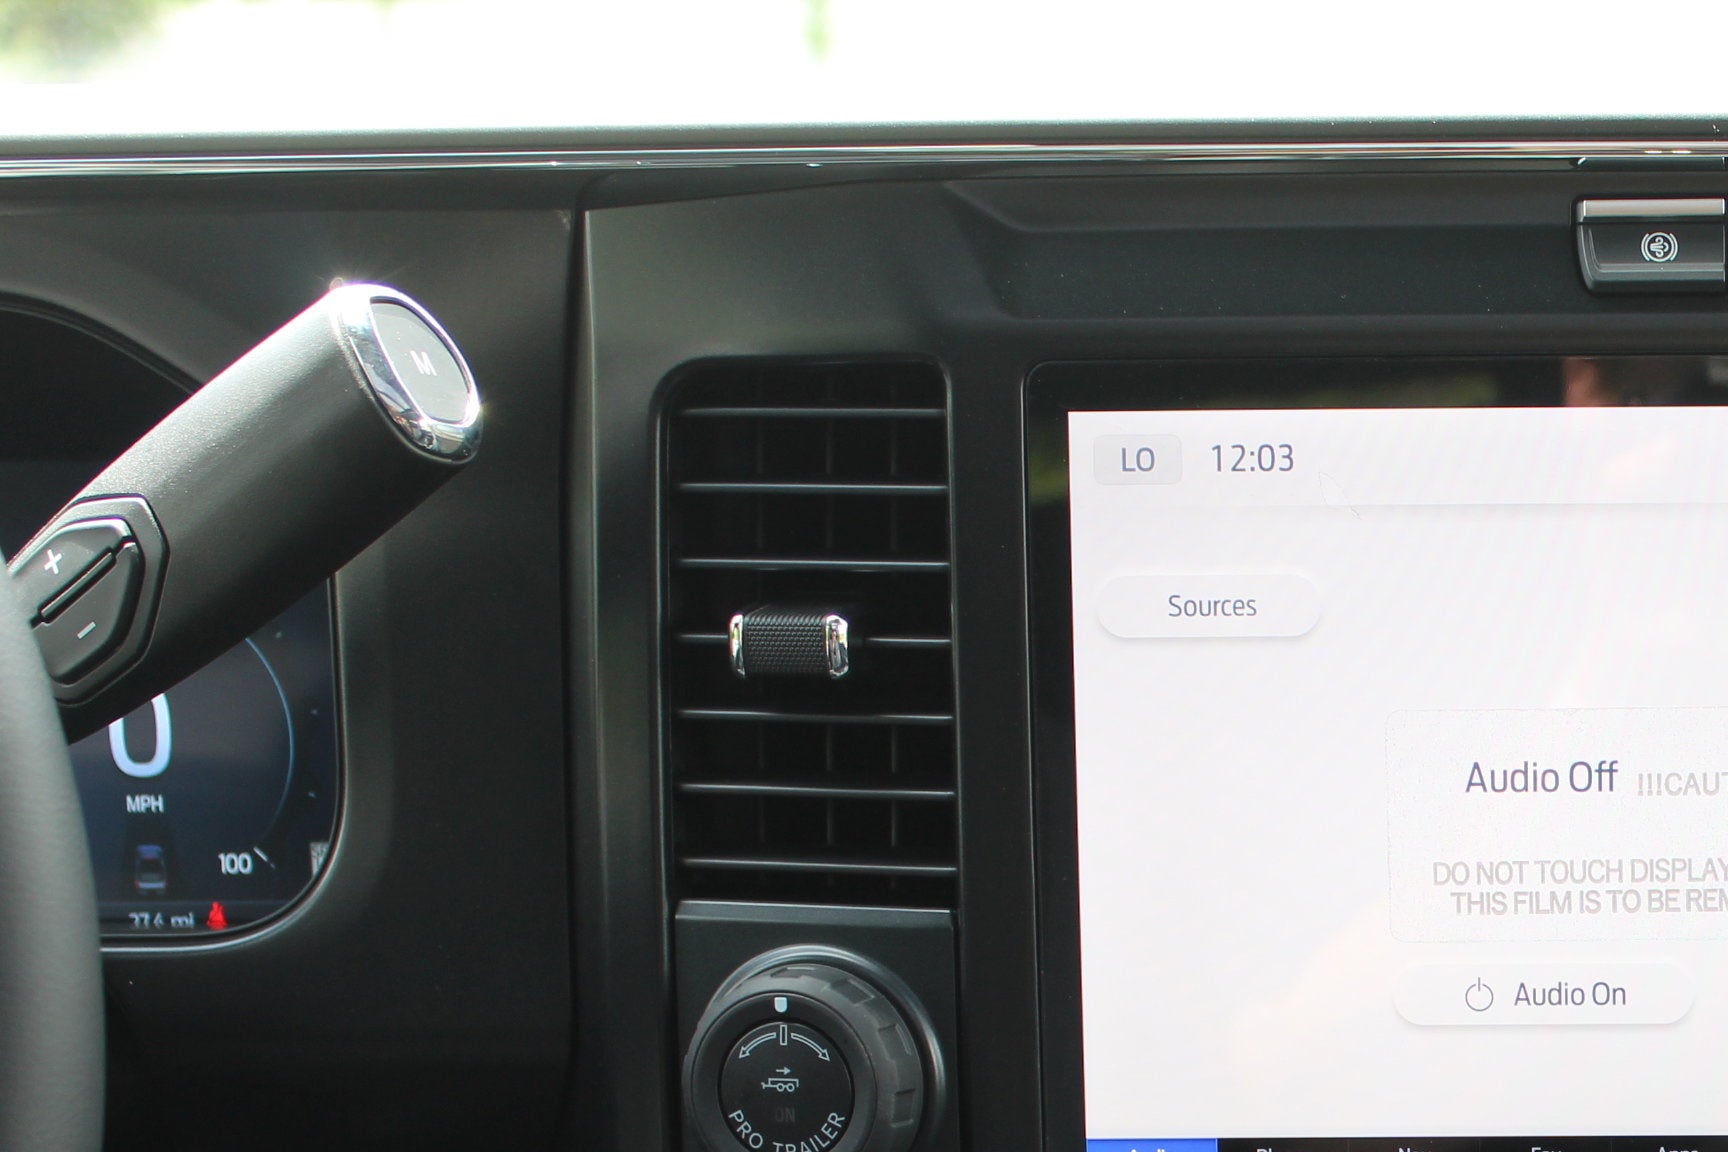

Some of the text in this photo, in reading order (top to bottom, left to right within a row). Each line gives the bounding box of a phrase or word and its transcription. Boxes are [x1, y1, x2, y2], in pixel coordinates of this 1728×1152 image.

[1121, 447, 1155, 472] LO
[1211, 443, 1294, 472] 12:03
[1168, 594, 1257, 618] Sources
[1465, 759, 1619, 793] Audio Off
[125, 794, 164, 813] MPH
[218, 852, 253, 875] 100
[1432, 860, 1471, 886] DO
[1476, 860, 1530, 886] NOT
[1533, 858, 1624, 885] TOUCH
[1449, 890, 1508, 916] THIS
[1513, 890, 1573, 915] FILM
[1579, 889, 1602, 915] IS
[1605, 888, 1642, 914] TO
[1647, 888, 1682, 913] BE
[1514, 981, 1626, 1007] Audio On
[728, 1109, 764, 1149] PRO
